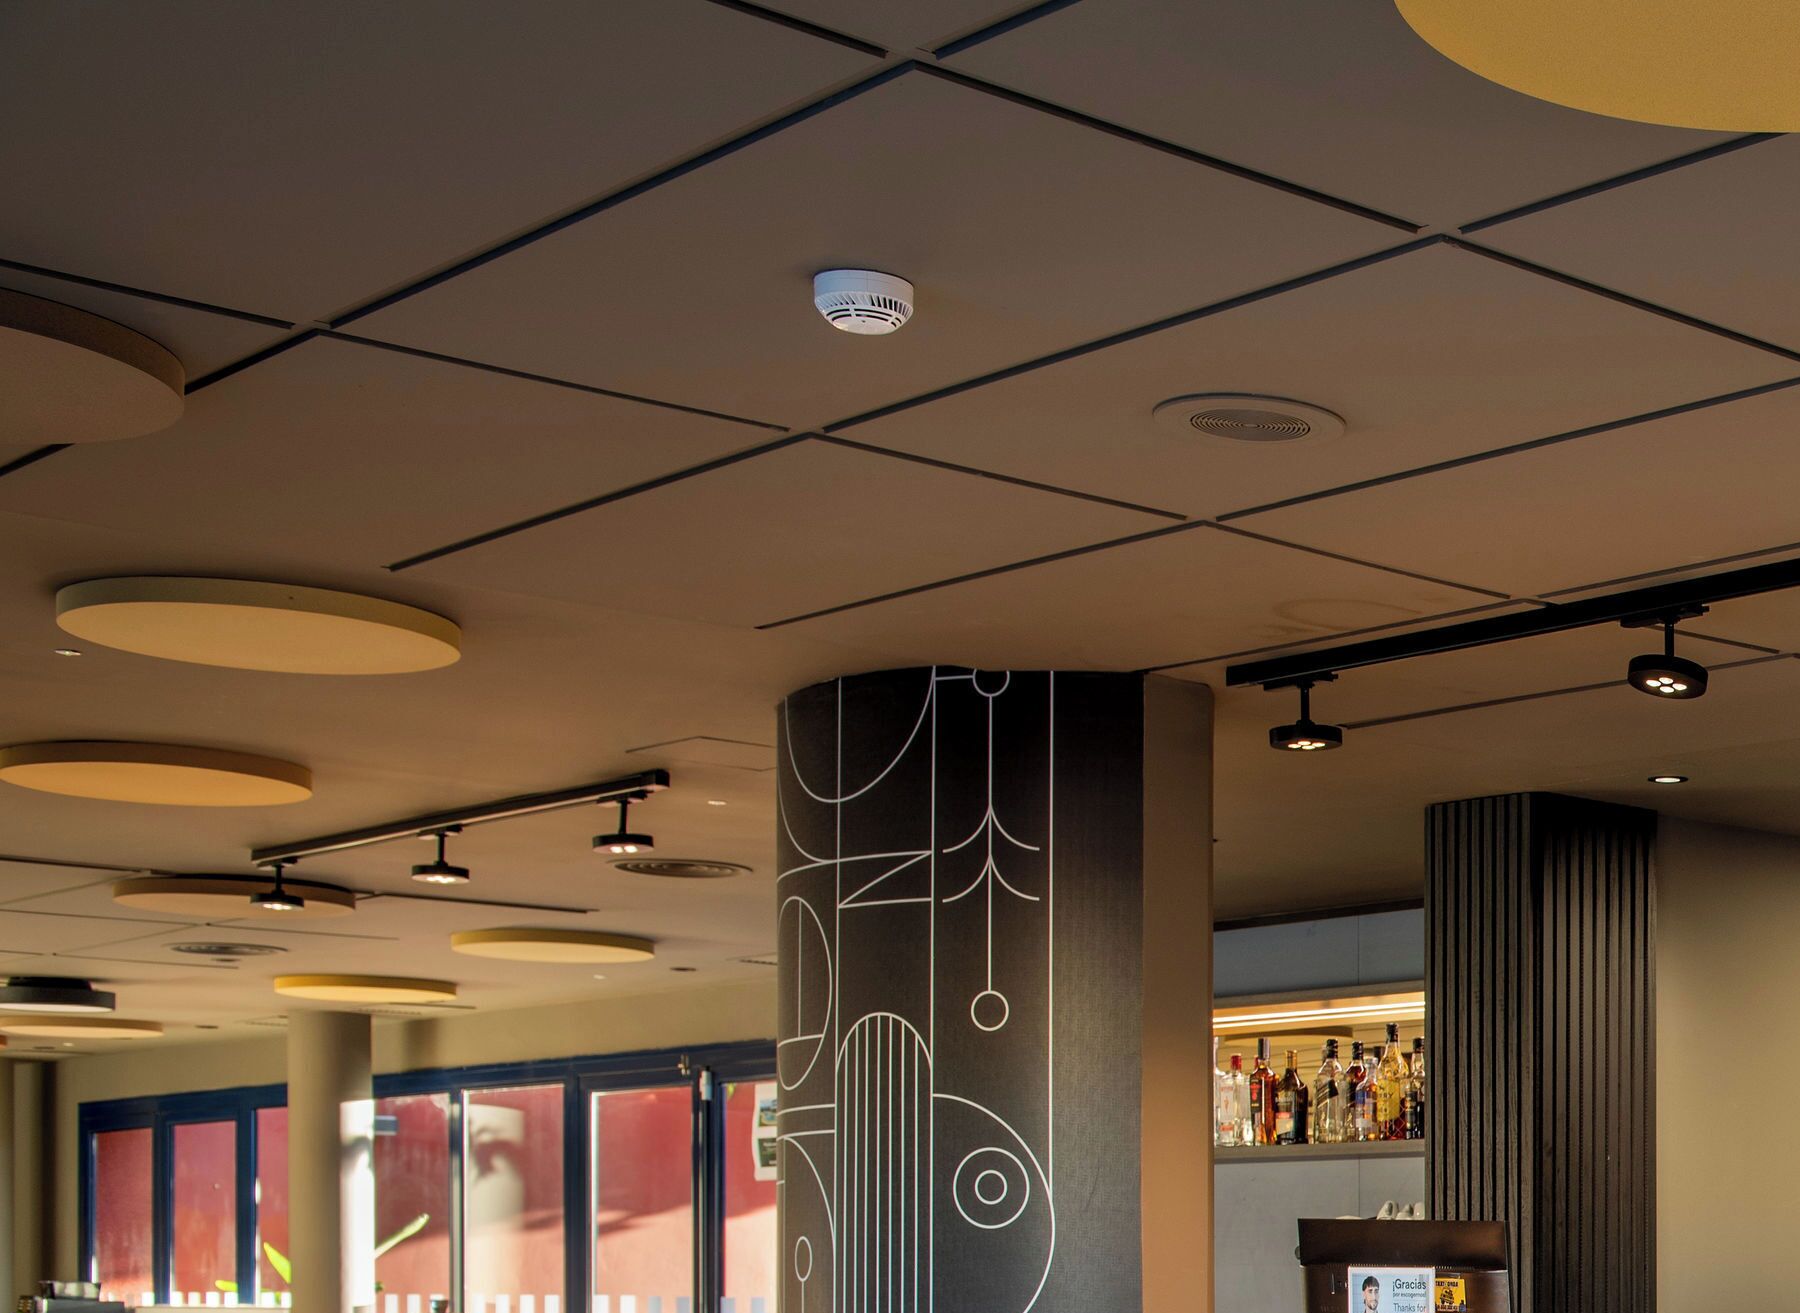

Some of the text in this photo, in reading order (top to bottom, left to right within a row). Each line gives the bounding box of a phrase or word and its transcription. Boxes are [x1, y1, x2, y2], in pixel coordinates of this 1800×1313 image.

[1393, 1278, 1427, 1291] ¡Gracias
[1393, 1302, 1416, 1312] Thanks
[1417, 1303, 1426, 1312] for
